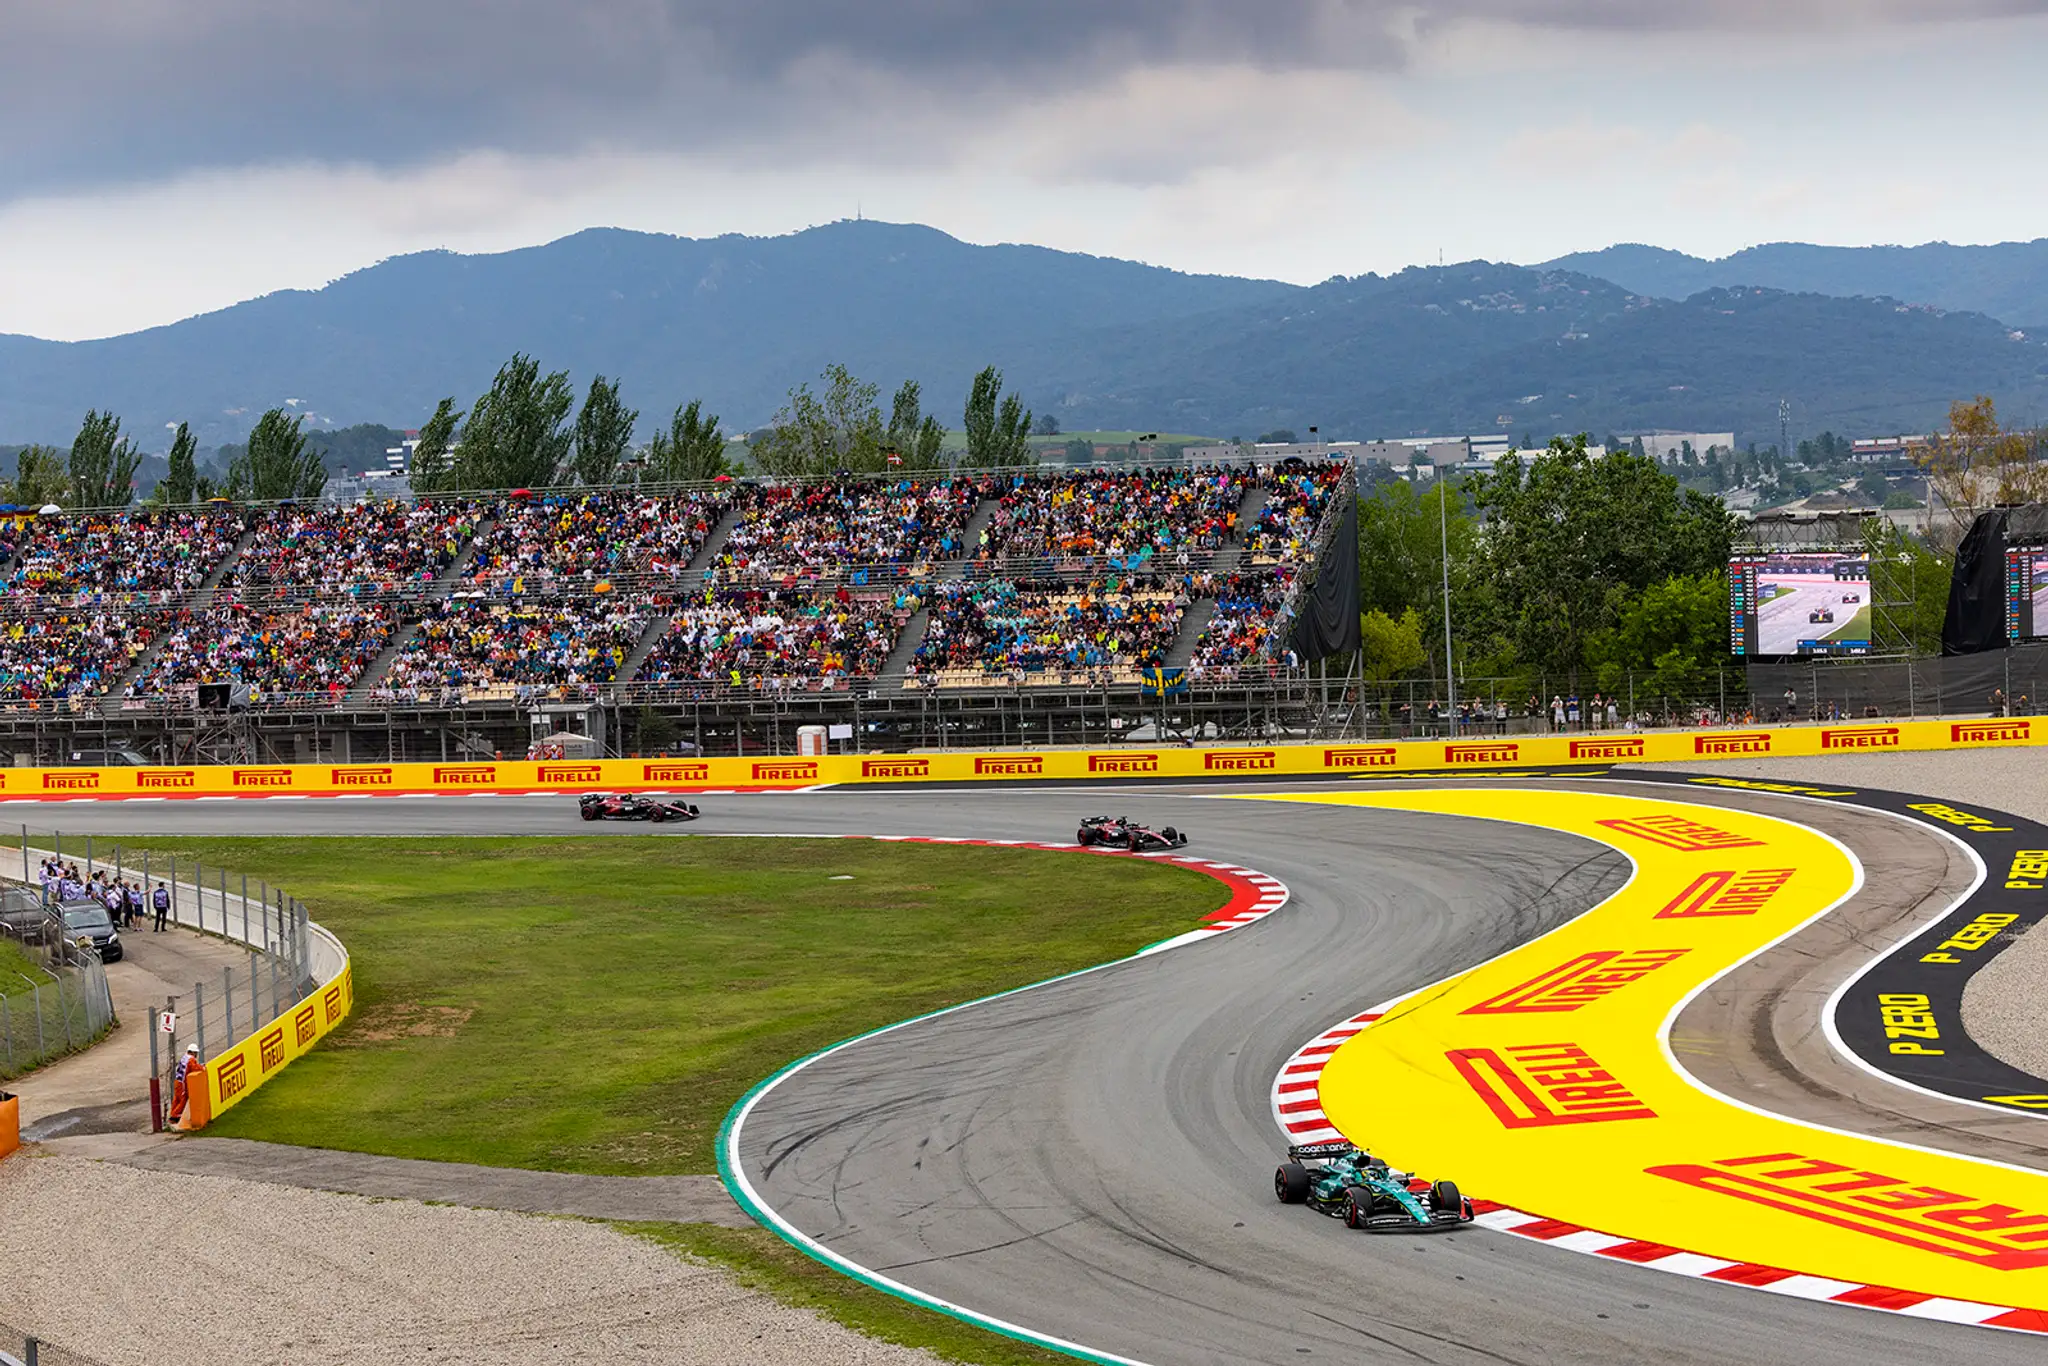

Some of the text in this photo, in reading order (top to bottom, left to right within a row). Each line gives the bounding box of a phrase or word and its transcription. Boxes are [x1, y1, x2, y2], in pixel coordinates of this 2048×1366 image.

[1822, 728, 1900, 748] PIRELLI
[1951, 722, 2030, 742] PIRELLI
[1445, 744, 1519, 762] PIRELLI
[1569, 739, 1644, 758] PIRELLI
[1695, 734, 1771, 754] PIRELLI
[974, 757, 1043, 774] PIRELLI
[1088, 754, 1159, 771] PIRELLI
[1204, 751, 1276, 769] PIRELLI
[1324, 748, 1397, 766] PIRELLI
[233, 770, 292, 786] PIRELLI
[331, 768, 392, 785] PIRELLI
[434, 767, 496, 783] PIRELLI
[537, 766, 601, 782] PIRELLI
[643, 764, 709, 781] PIRELLI
[752, 762, 818, 779] PIRELLI
[861, 760, 929, 777] PIRELLI
[43, 772, 99, 788] PIRELLI
[137, 771, 194, 787] PIRELLI
[1906, 803, 1994, 825] ZERO
[1595, 815, 1767, 852] PIRELLI
[2005, 850, 2048, 889] P ZERO
[1653, 868, 1796, 919] PIRELLI
[1919, 913, 2019, 963] P ZERO
[1457, 948, 1692, 1016] PIRELLI
[295, 1004, 315, 1048] PIRELLI
[1878, 994, 1945, 1055] P ZERO
[259, 1027, 285, 1074] PIRELLI
[217, 1052, 247, 1103] PIRELLI
[1444, 1043, 1659, 1129] PIRELLI
